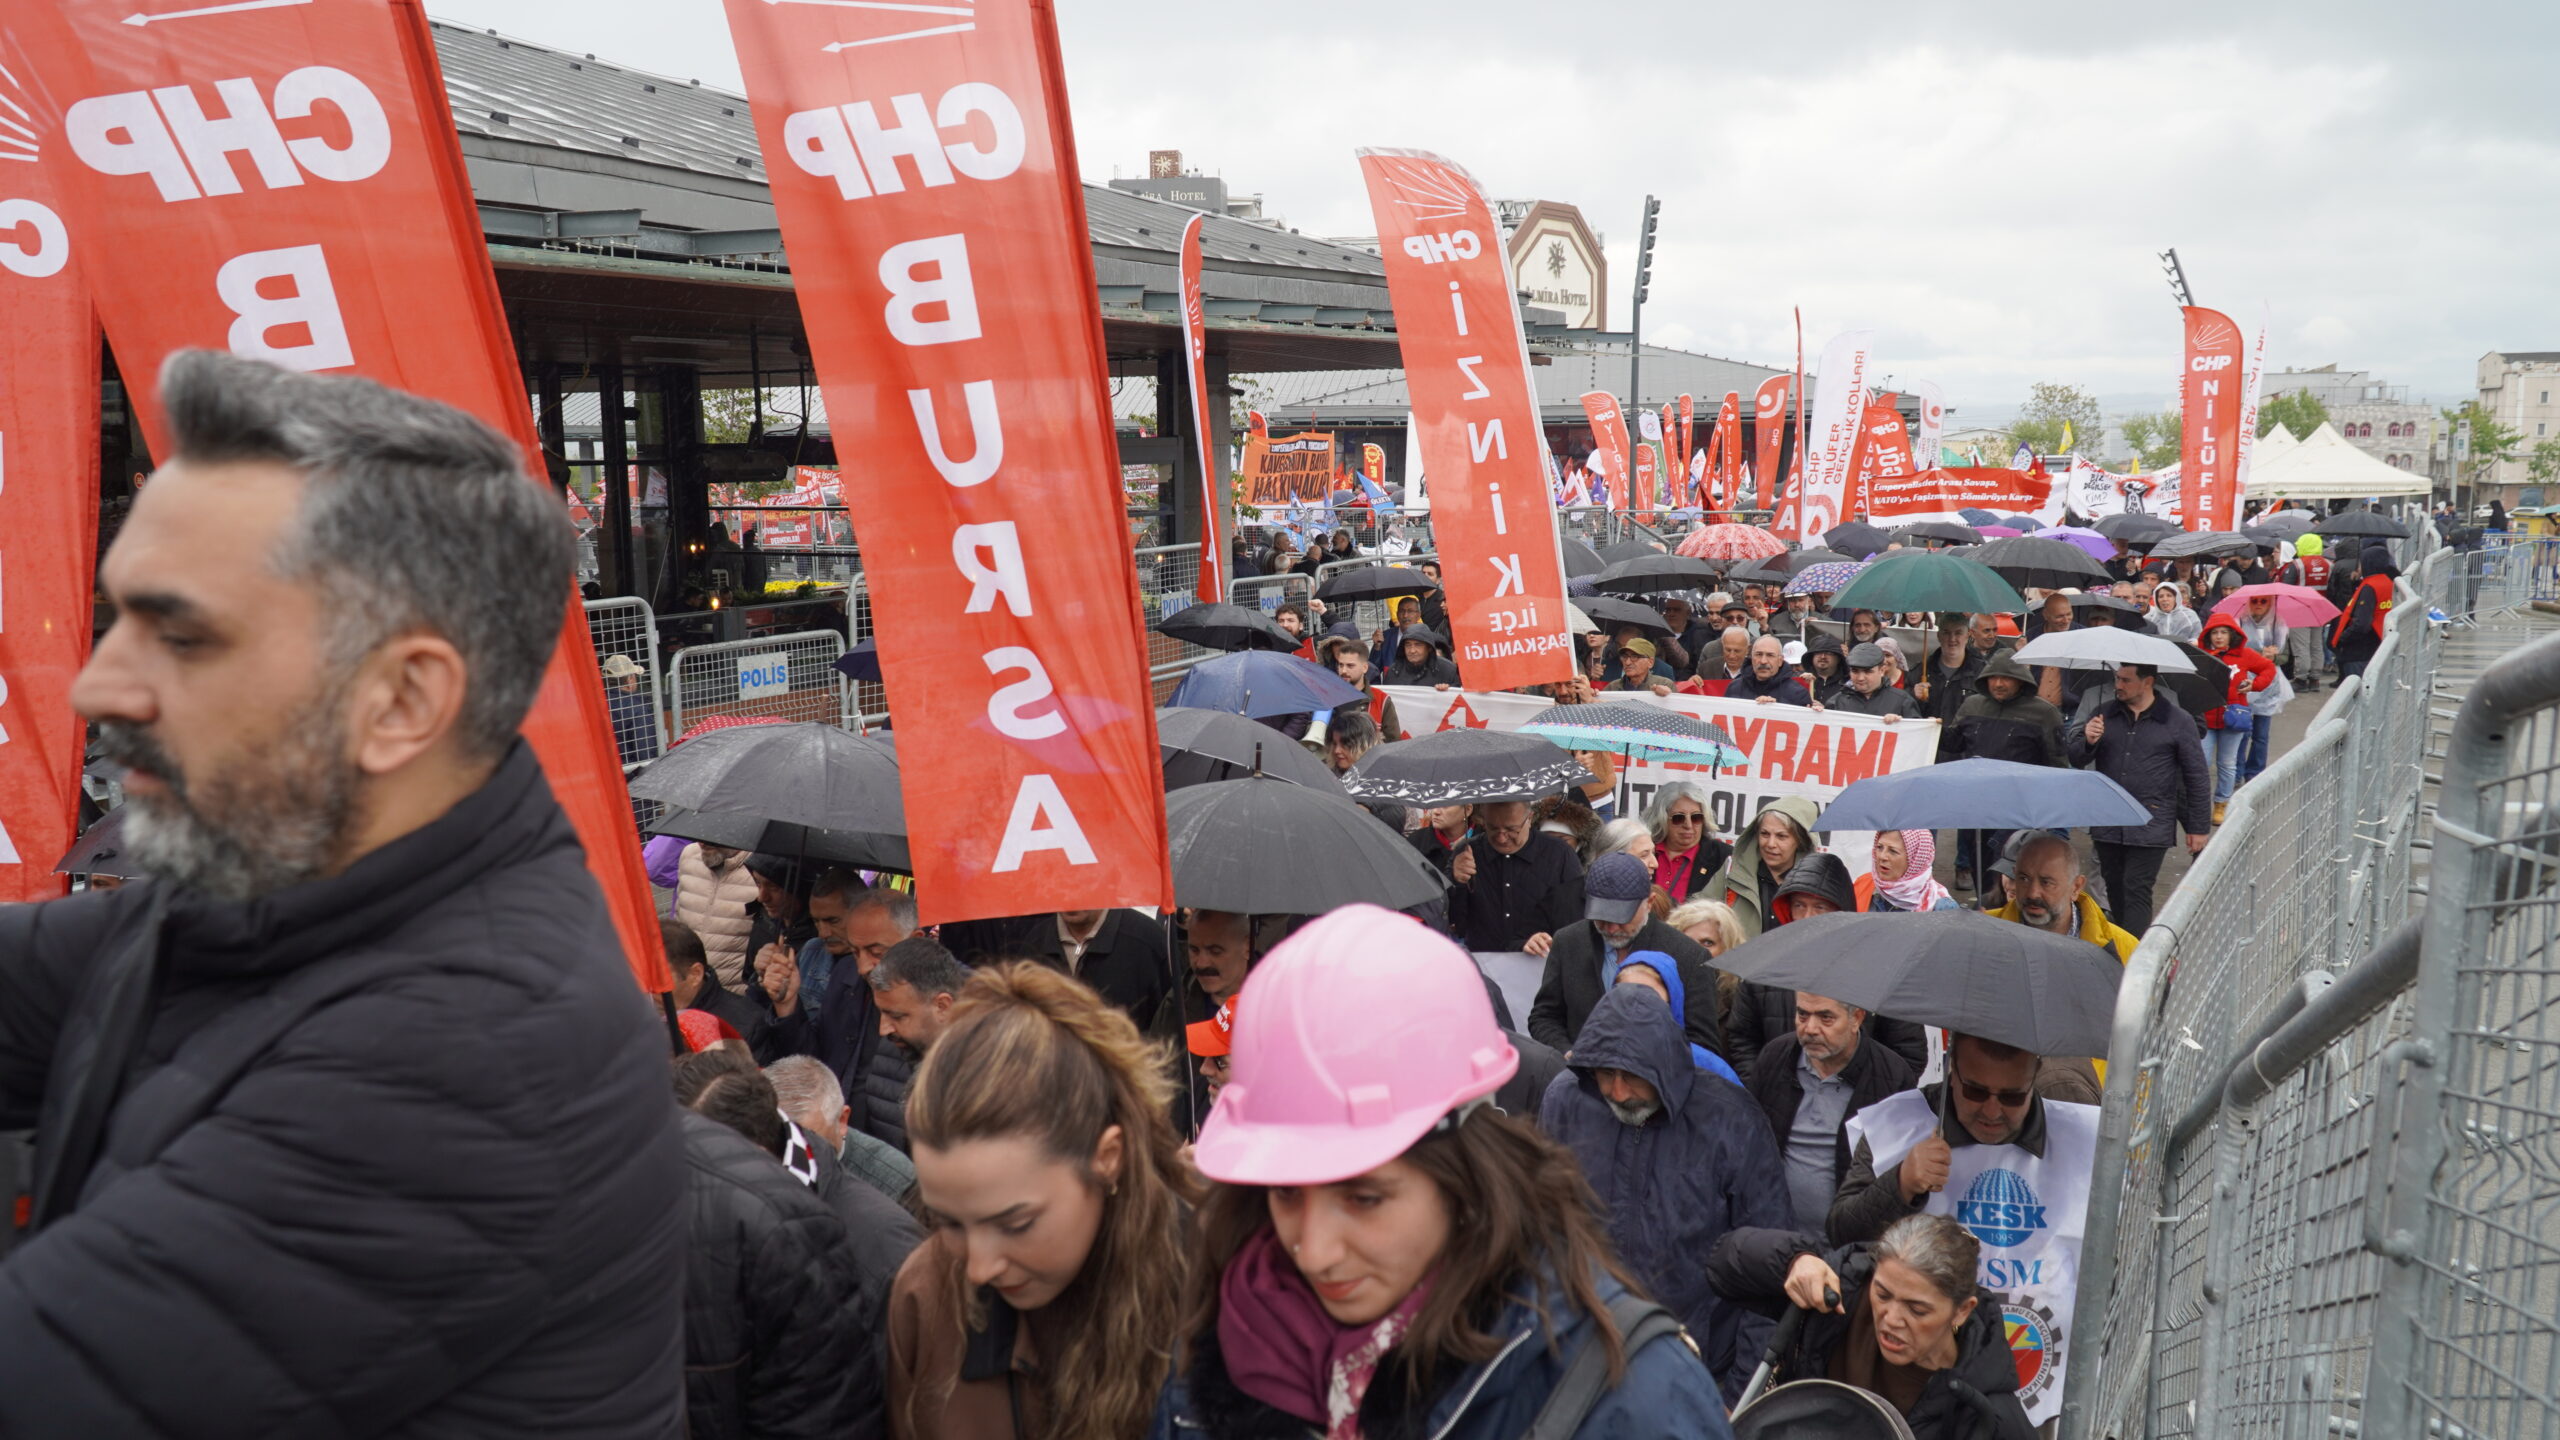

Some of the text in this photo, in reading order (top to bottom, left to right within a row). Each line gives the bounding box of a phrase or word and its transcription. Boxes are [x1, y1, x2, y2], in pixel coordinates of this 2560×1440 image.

[1170, 190, 1207, 201] HOTEL
[1560, 288, 1589, 307] HOTEL
[2191, 355, 2232, 372] CHP
[1807, 451, 1821, 485] CHP
[1874, 480, 1938, 491] Emperyalistler
[1960, 492, 2007, 503] Sömürüye
[1261, 594, 1286, 610] POLİS
[740, 662, 787, 689] POLİS
[1957, 1200, 2048, 1229] KESK
[1990, 1231, 2014, 1244] 1995
